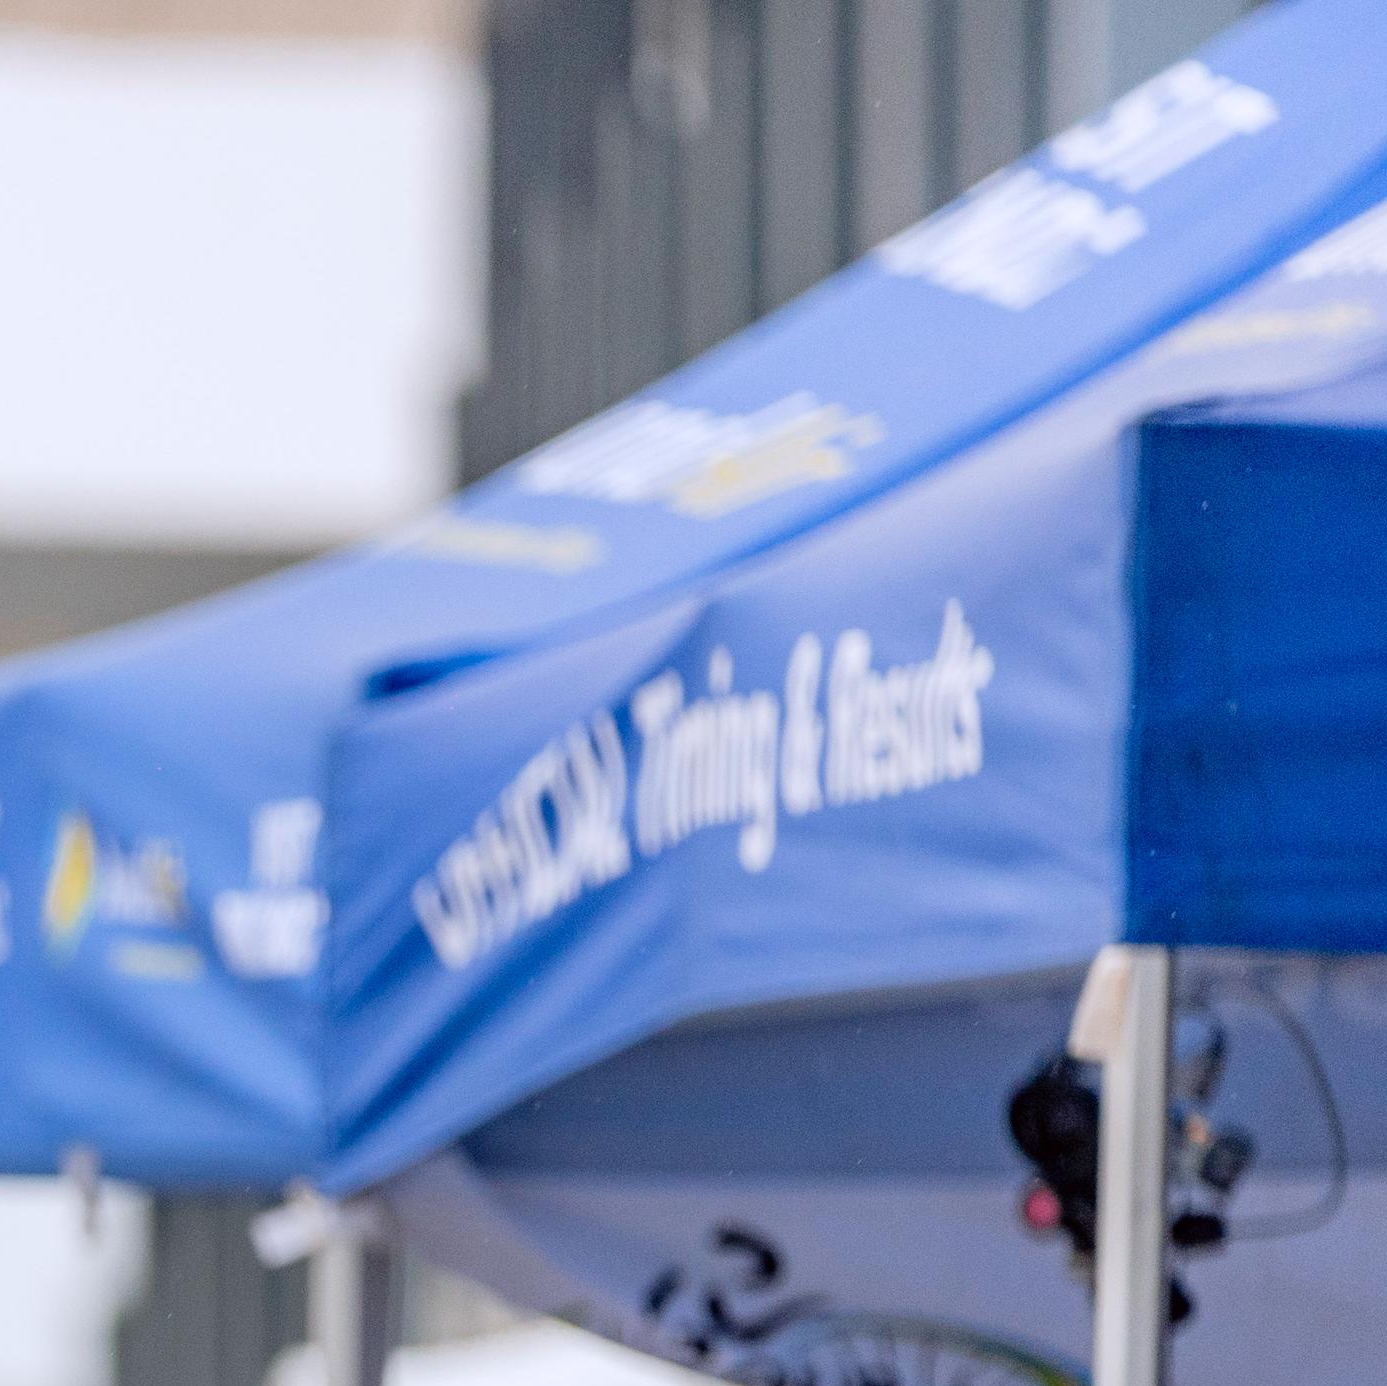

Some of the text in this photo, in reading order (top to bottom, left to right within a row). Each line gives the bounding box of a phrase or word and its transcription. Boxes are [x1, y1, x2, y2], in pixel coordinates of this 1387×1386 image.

[633, 642, 780, 872] Timing
[782, 632, 825, 816] &
[829, 596, 995, 806] Results
